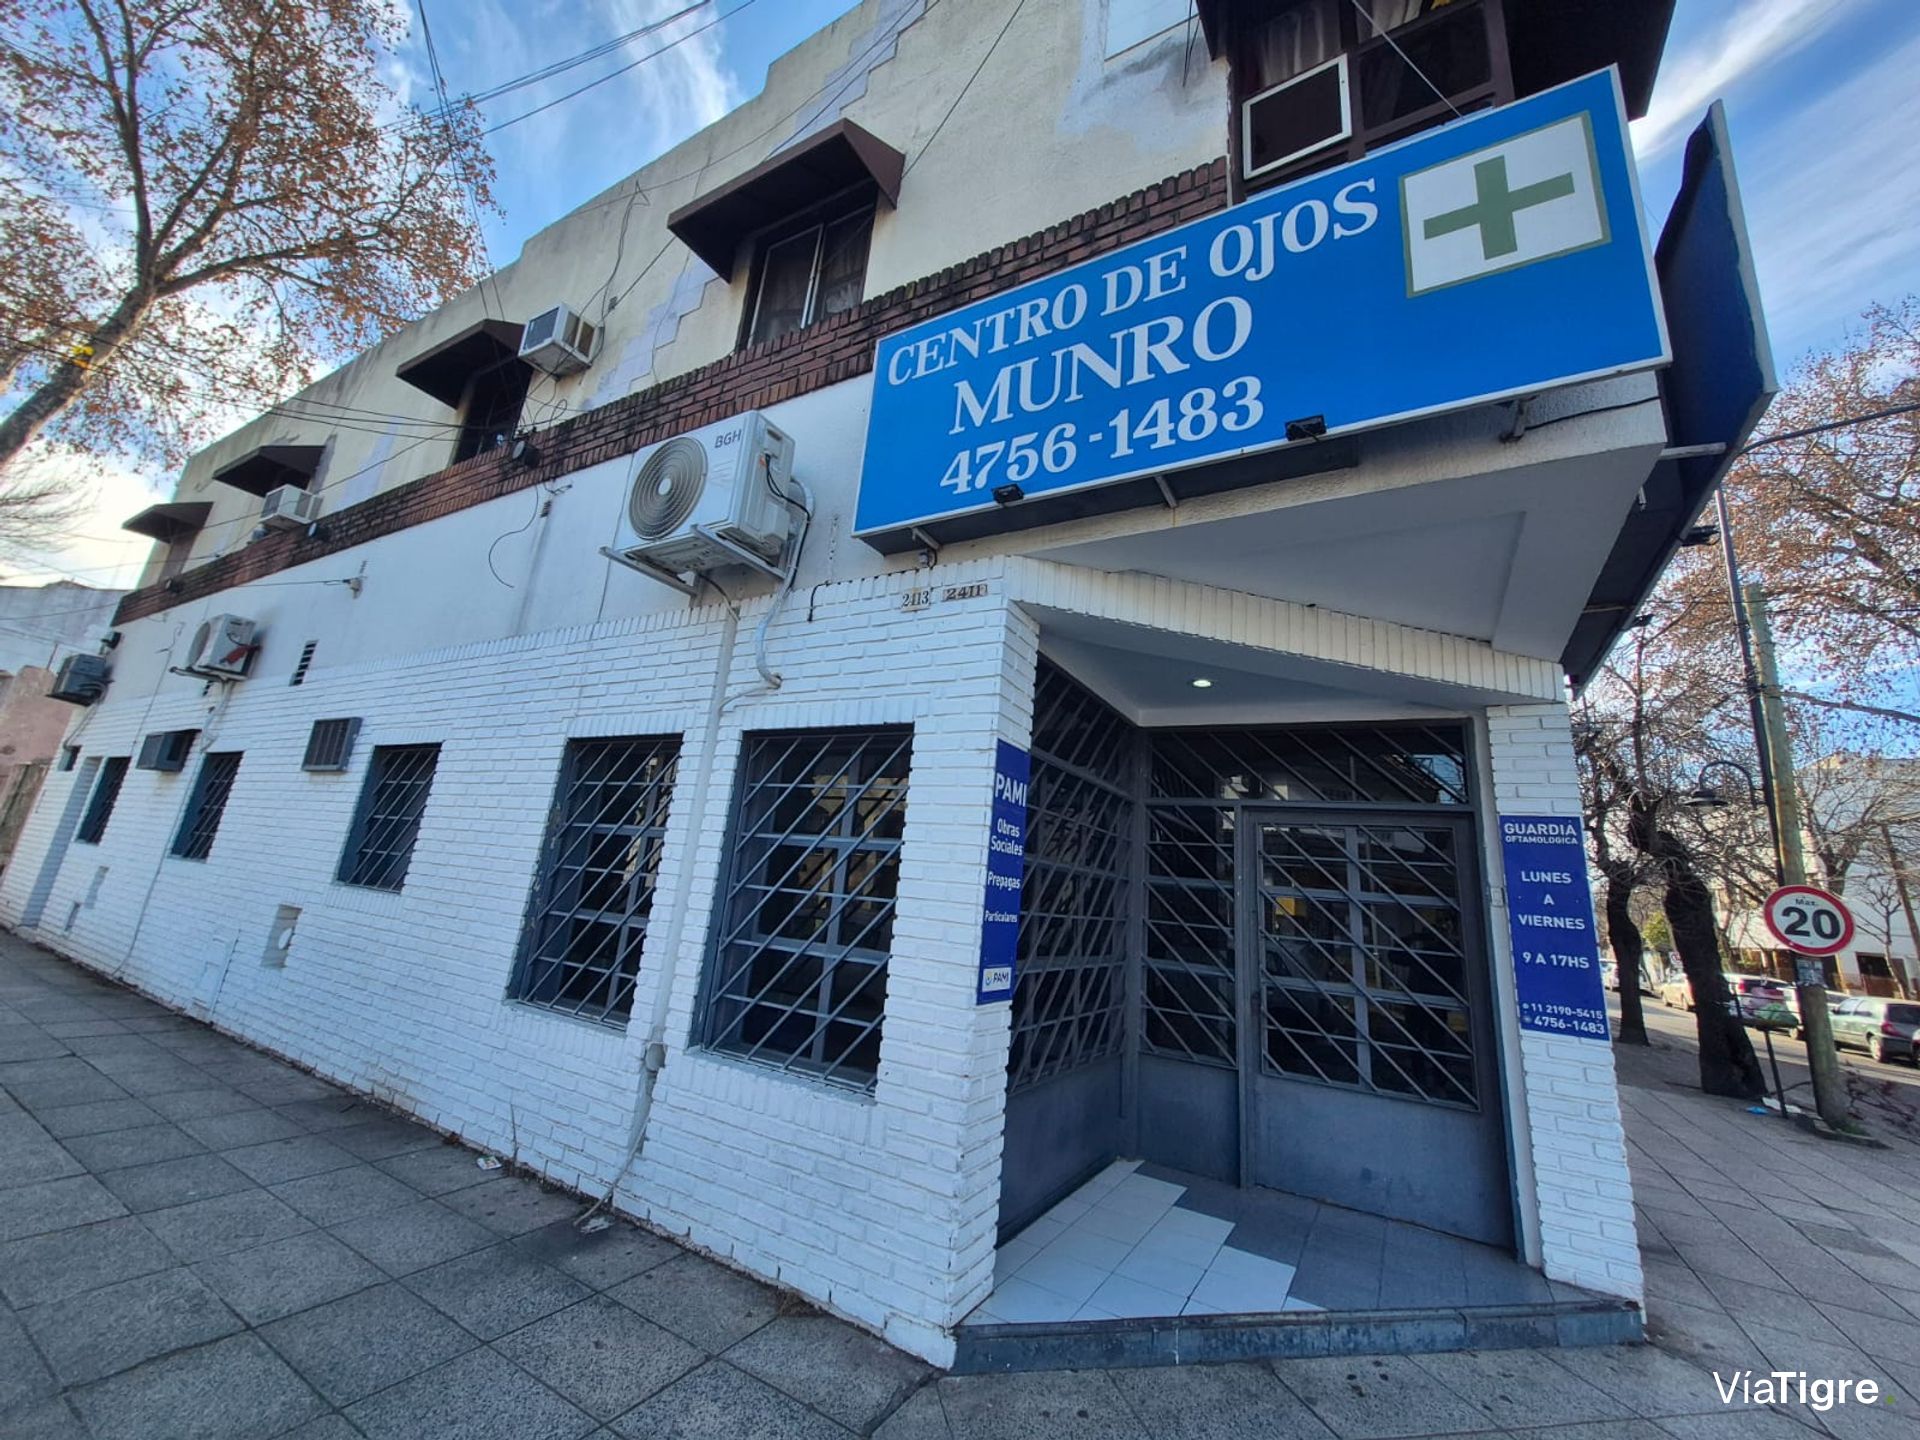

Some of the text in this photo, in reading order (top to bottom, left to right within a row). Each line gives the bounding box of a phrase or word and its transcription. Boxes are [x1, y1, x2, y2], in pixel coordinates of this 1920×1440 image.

[887, 177, 1379, 386] CENTRO DE OJOS
[948, 296, 1253, 435] MUNRO
[714, 428, 742, 449] BGH
[994, 772, 1028, 808] PAMI
[997, 817, 1020, 838] Obras
[1504, 822, 1577, 836] GUARDIA
[990, 835, 1023, 856] Sociales
[986, 870, 1021, 891] Prepagas
[1520, 871, 1572, 884] LUNES
[1543, 893, 1555, 906] A
[1518, 914, 1586, 930] VIERNES
[1781, 906, 1841, 940] 20
[1522, 951, 1590, 969] 9 A 17HS
[992, 971, 1009, 985] PAMI
[1531, 1003, 1543, 1013] 11
[1533, 1015, 1606, 1035] 4756-1483
